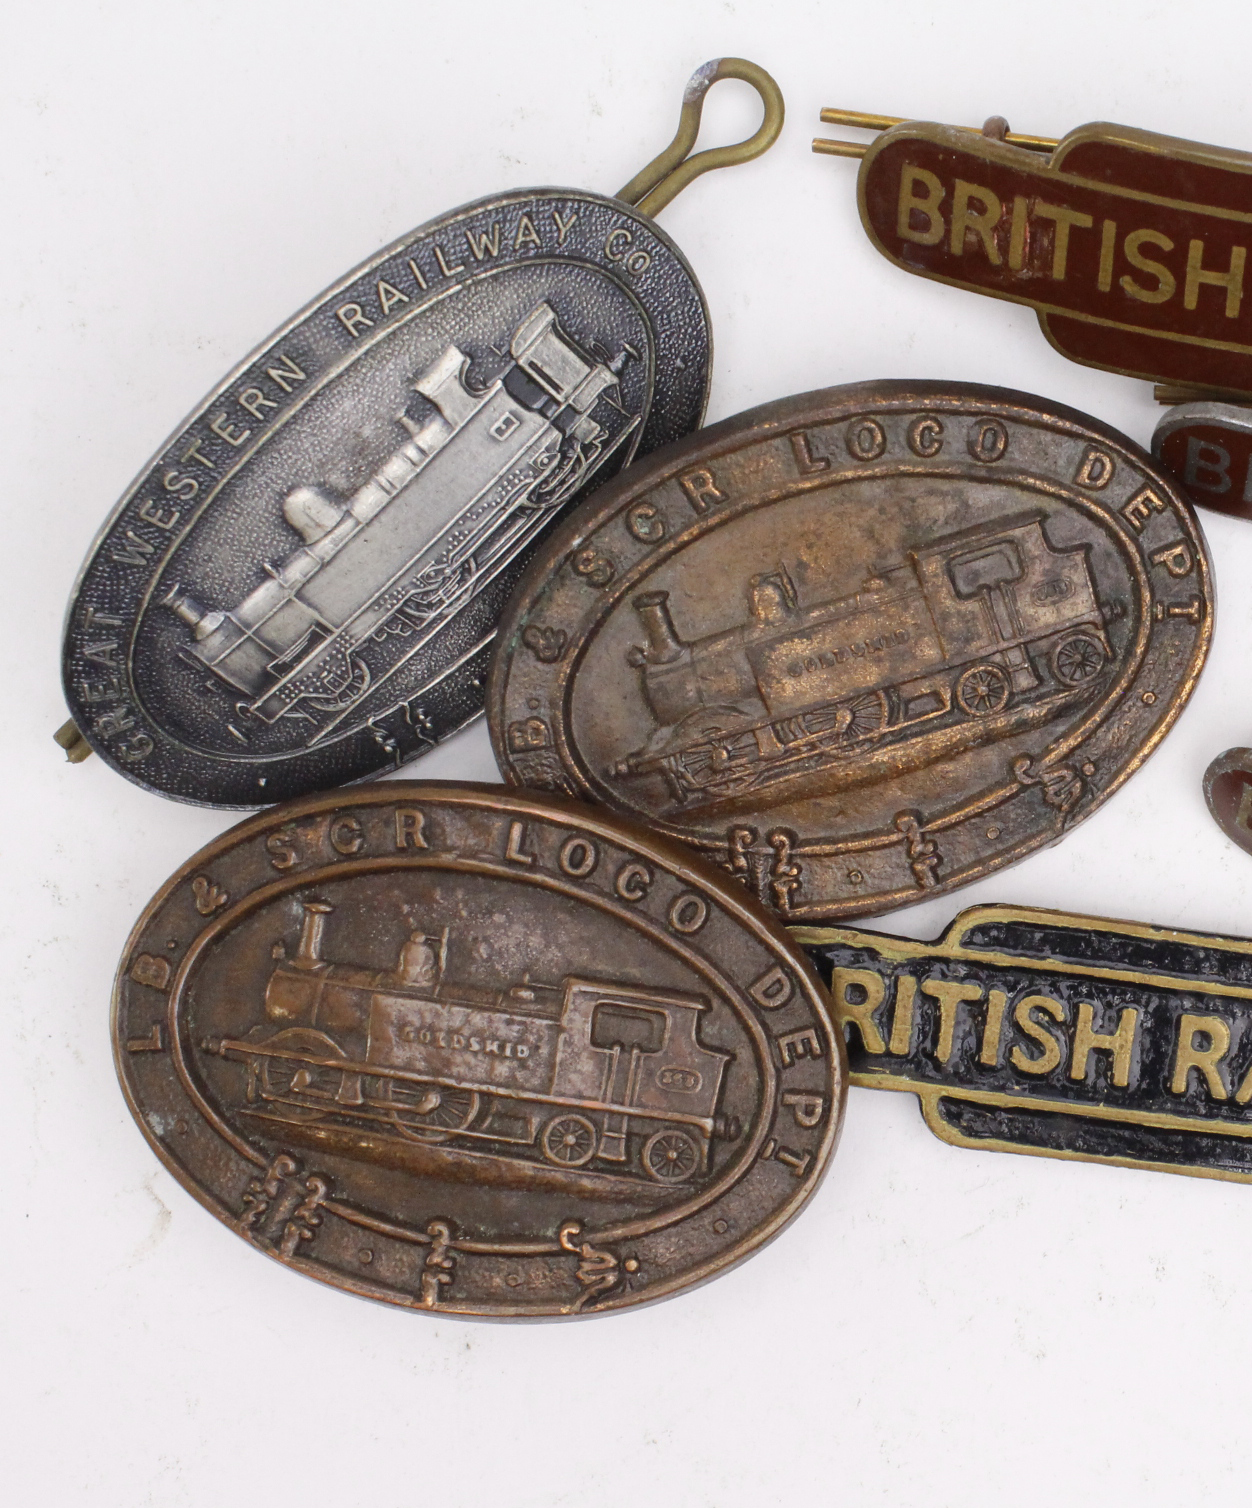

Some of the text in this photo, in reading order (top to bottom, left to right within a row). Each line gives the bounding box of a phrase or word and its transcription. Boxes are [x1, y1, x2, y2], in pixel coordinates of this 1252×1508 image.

[335, 210, 580, 337] RAILWAY
[896, 163, 1247, 320] BRITISH
[113, 356, 307, 566] WESTERN
[794, 415, 1009, 474] LOCO
[572, 467, 730, 588] SCR
[83, 605, 154, 761] GREAT
[524, 626, 567, 661] &
[508, 698, 552, 753] B.
[192, 876, 228, 914] &
[267, 810, 429, 870] SCR
[507, 821, 709, 935] LOCO
[832, 966, 1137, 1088] RITISH
